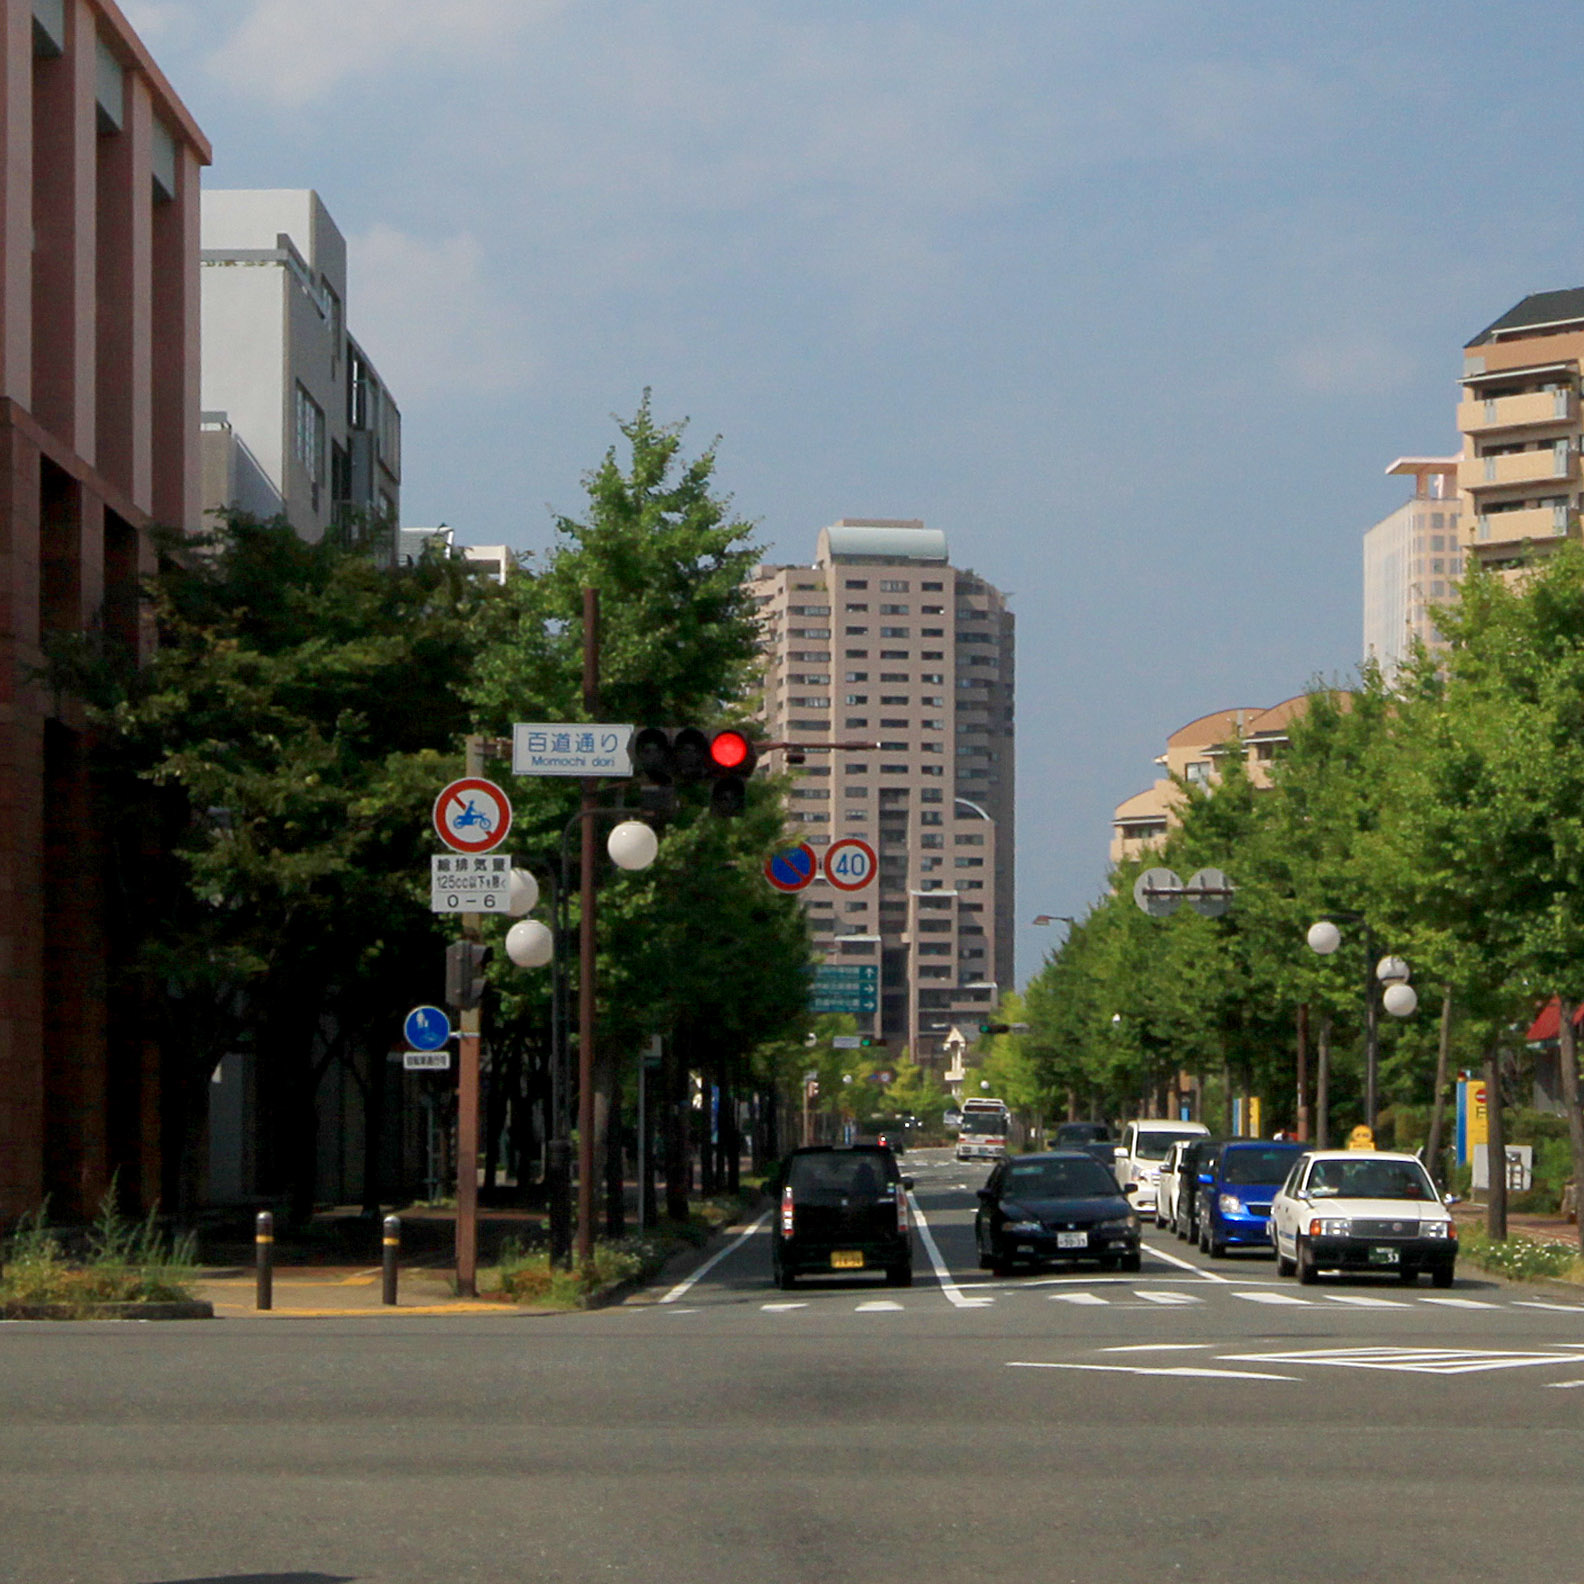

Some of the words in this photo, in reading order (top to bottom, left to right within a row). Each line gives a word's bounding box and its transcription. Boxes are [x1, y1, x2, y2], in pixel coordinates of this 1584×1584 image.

[528, 732, 618, 753] 百道通り
[531, 756, 585, 767] Momochi
[592, 757, 615, 767] dori
[836, 853, 865, 876] 40
